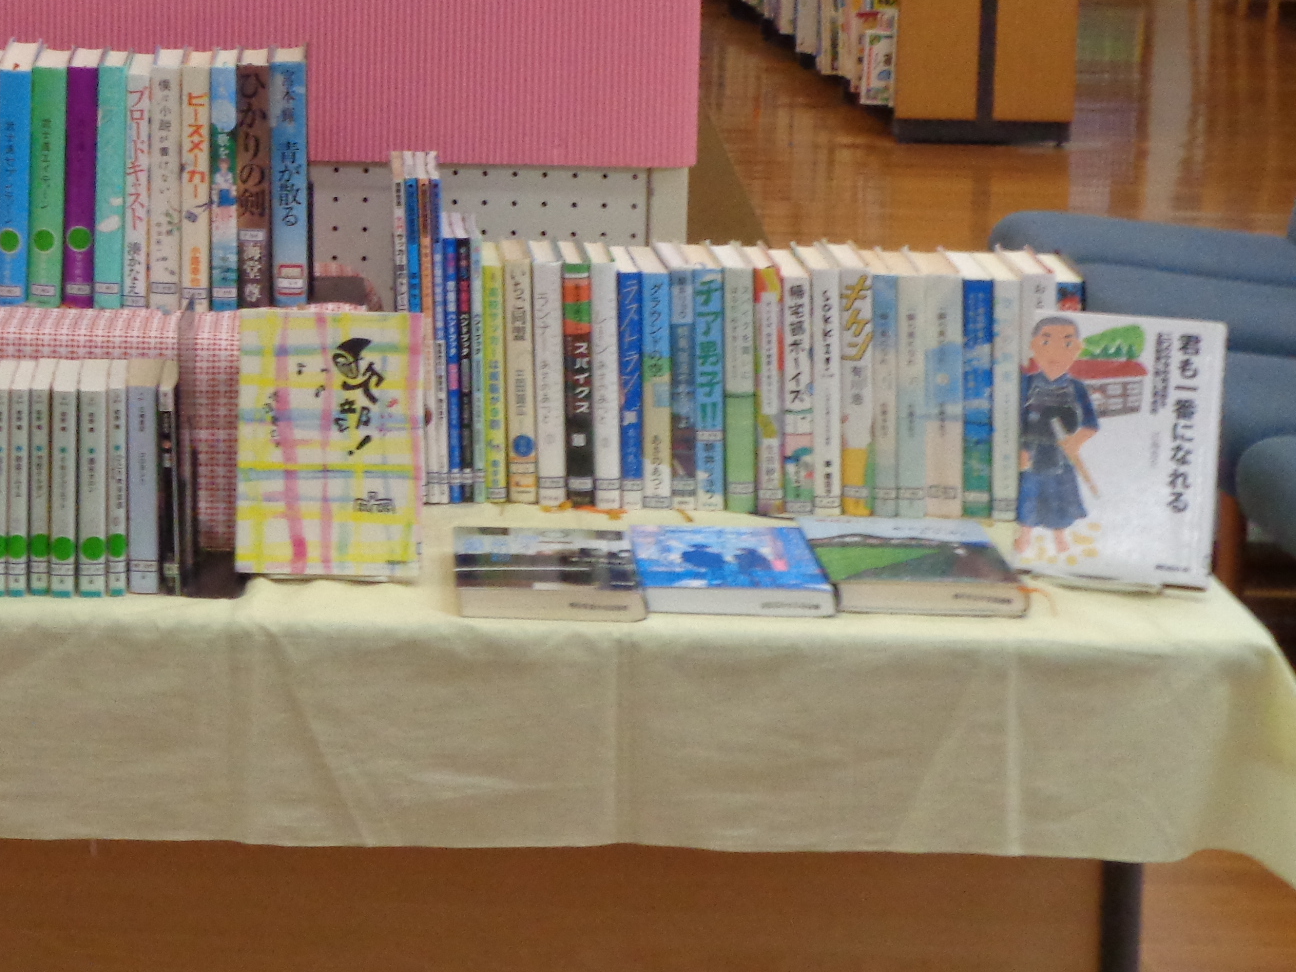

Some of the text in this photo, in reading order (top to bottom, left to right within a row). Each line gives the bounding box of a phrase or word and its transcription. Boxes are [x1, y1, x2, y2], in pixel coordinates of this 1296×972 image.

[238, 72, 268, 218] ひかりの剣
[277, 140, 303, 227] 青が散る
[694, 279, 722, 428] チア男子!!
[840, 275, 873, 361] キケン
[573, 342, 590, 415] スパイクス
